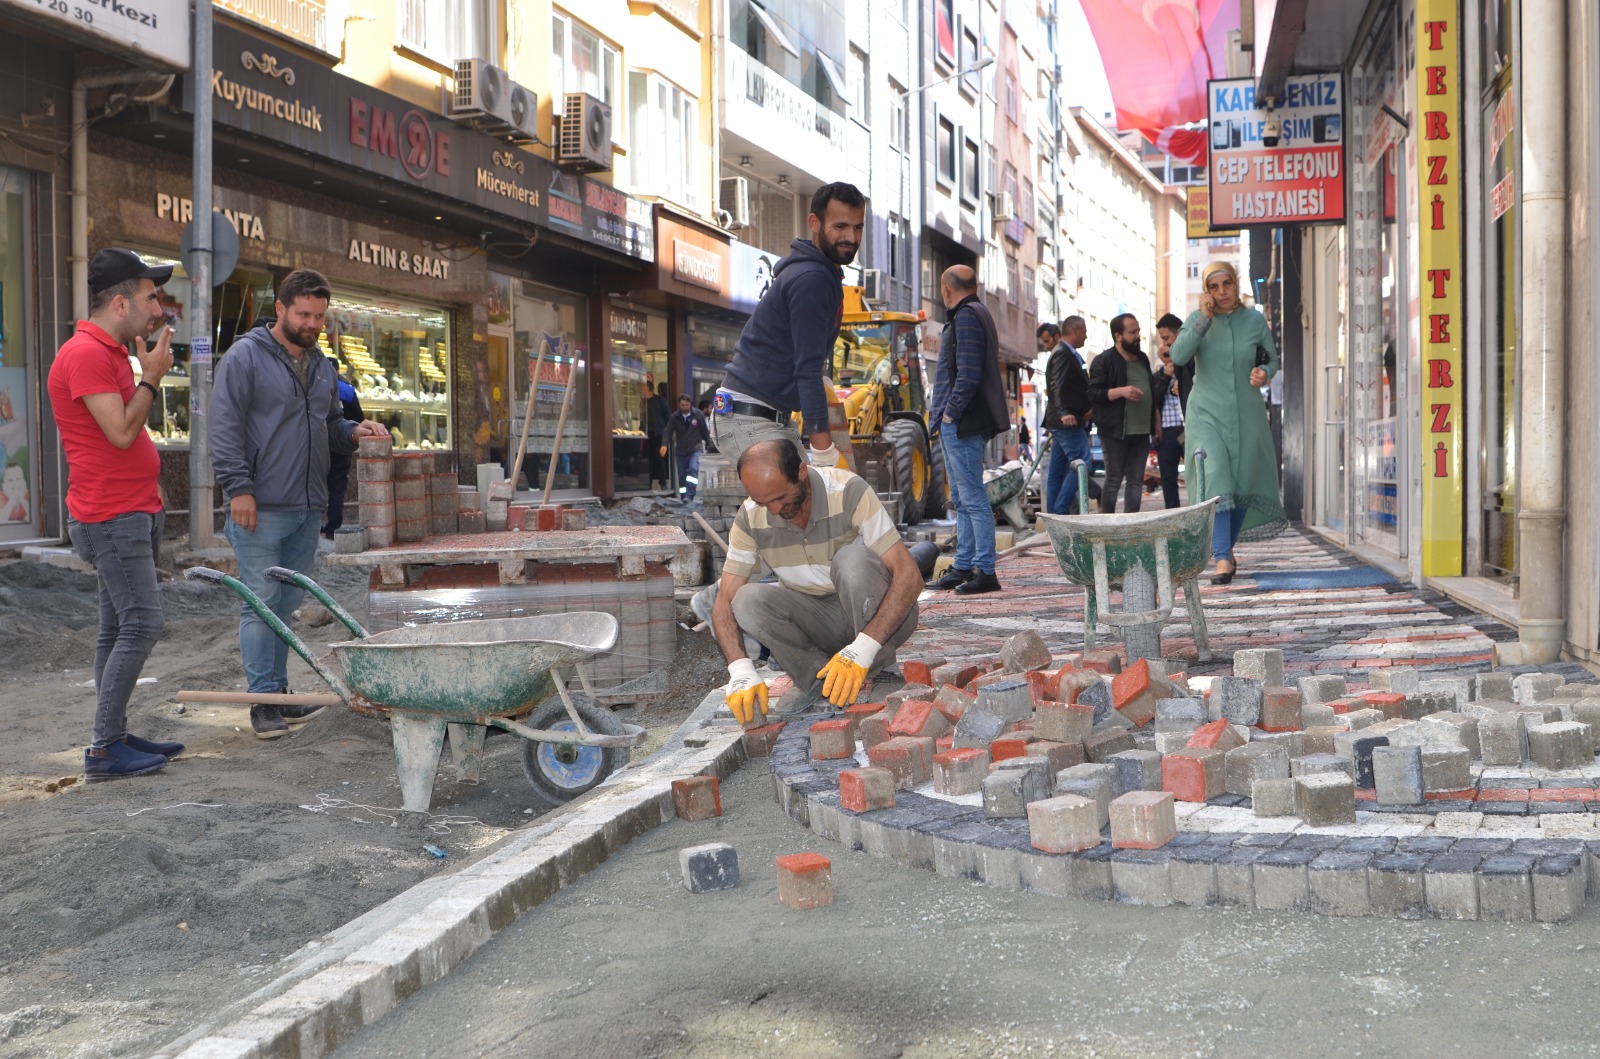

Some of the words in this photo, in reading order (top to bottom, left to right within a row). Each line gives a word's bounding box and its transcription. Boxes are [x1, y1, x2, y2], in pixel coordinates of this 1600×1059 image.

[74, 7, 93, 24] 30
[211, 70, 322, 133] Kuyumculuk
[1216, 77, 1337, 112] KARENİZ
[350, 96, 450, 180] EMRE
[1243, 113, 1311, 145] İLEŞİM
[1424, 21, 1451, 231] TERZİ
[477, 166, 539, 208] Mücevherat
[1216, 156, 1249, 184] CEP
[1254, 151, 1339, 182] TELEFONU
[157, 192, 265, 240] PIRNTA
[1232, 181, 1325, 219] HASTANESİ
[349, 239, 396, 269] ALTIN
[399, 250, 410, 272] &
[413, 255, 450, 280] SAAT
[840, 324, 879, 332] AŞALLAH
[1428, 269, 1454, 478] TERZİ
